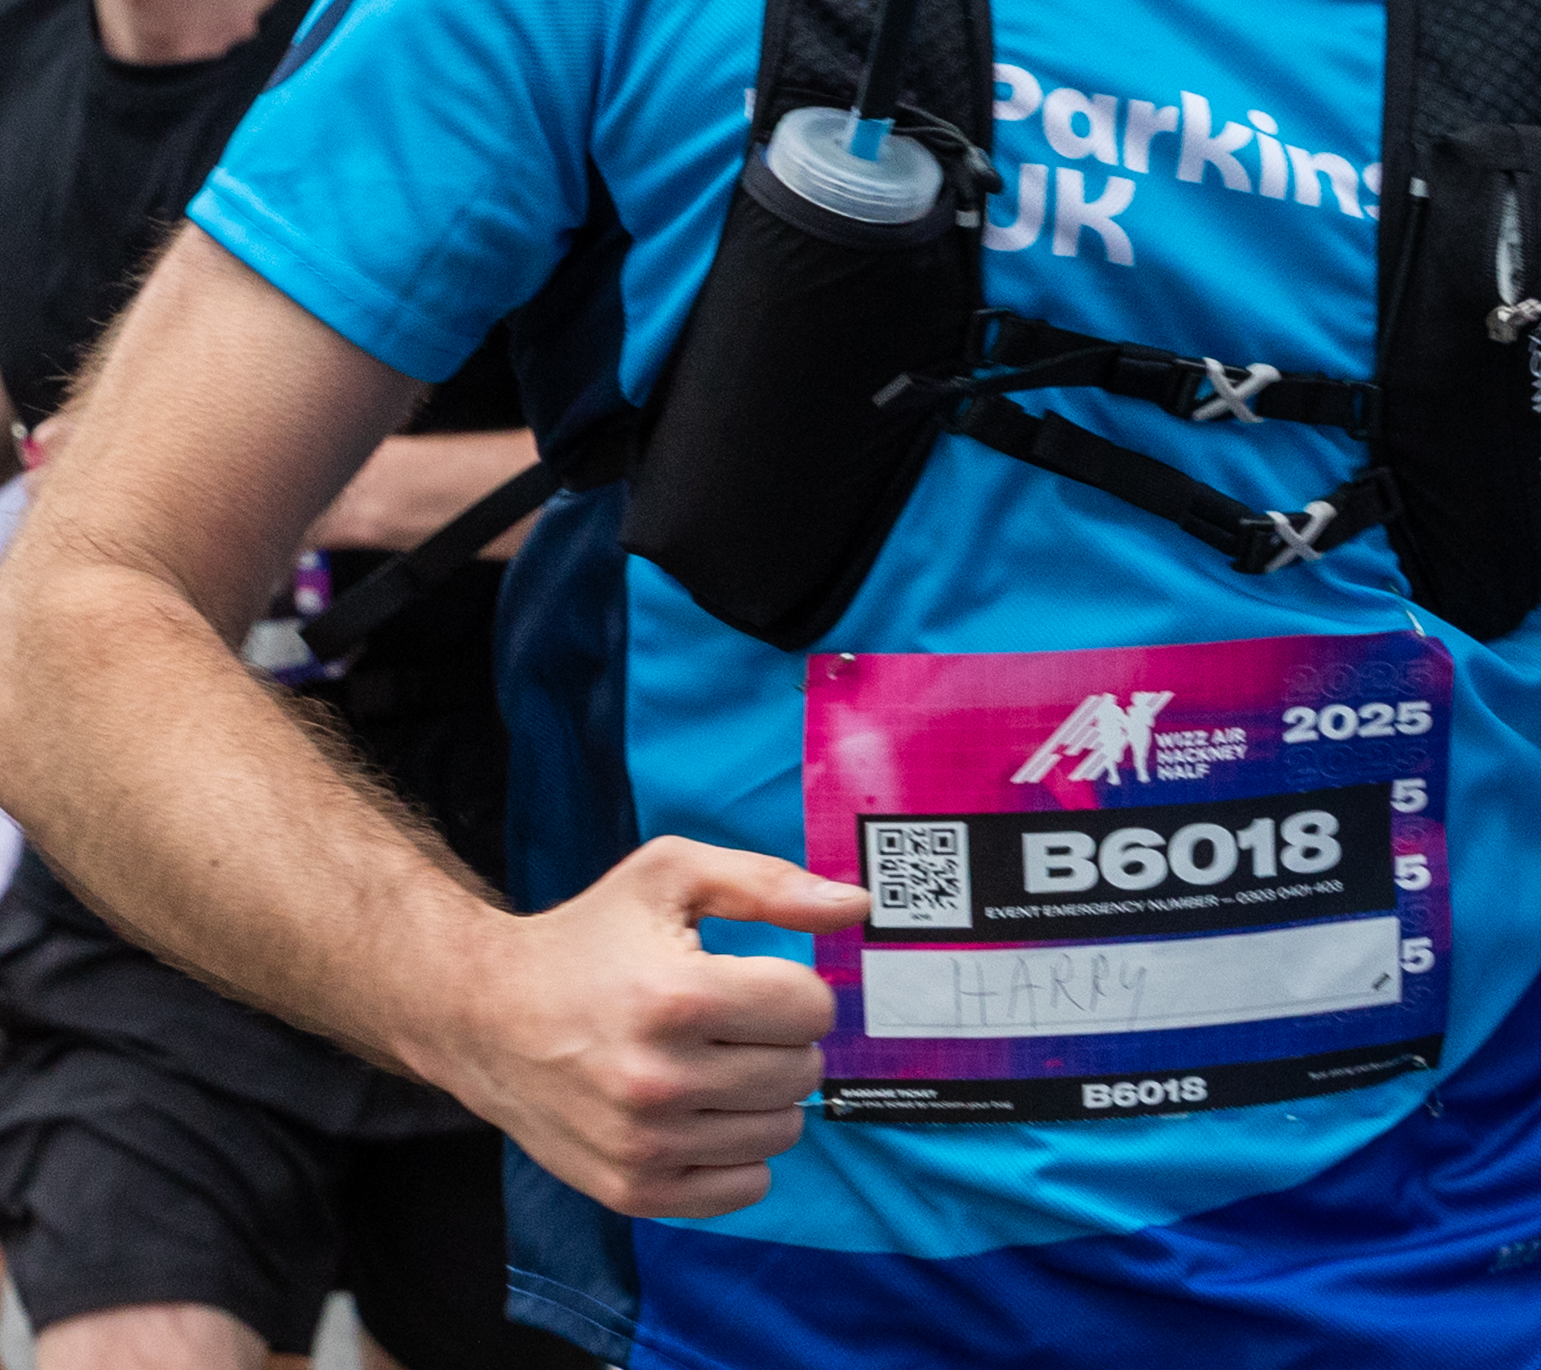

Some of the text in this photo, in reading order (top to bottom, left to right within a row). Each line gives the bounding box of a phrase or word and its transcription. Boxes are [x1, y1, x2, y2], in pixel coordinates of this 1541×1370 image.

[1154, 727, 1247, 748] WIZZ AIR
[1283, 700, 1433, 743] 2025
[1156, 744, 1248, 765] HACKNEY
[1156, 762, 1210, 781] HALF
[1021, 810, 1343, 894] B6018
[949, 952, 1149, 1030] HARRY
[1081, 1076, 1208, 1108] B6018
